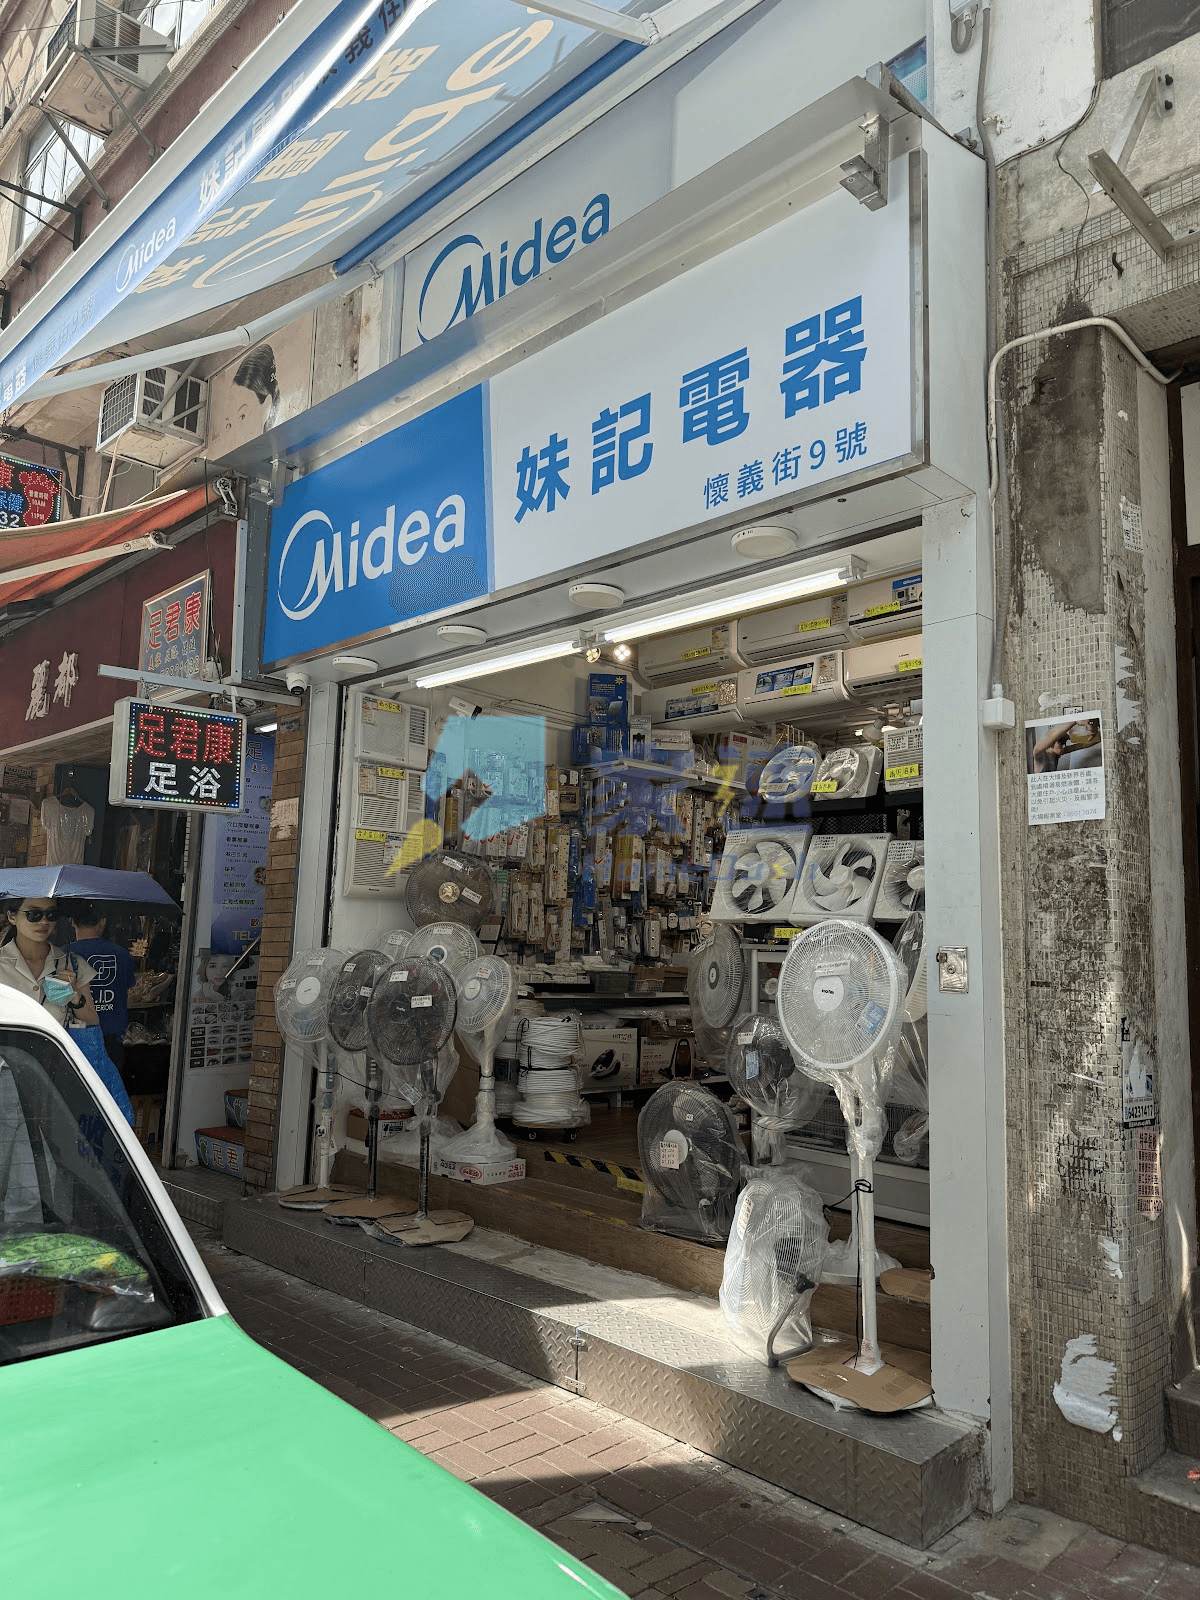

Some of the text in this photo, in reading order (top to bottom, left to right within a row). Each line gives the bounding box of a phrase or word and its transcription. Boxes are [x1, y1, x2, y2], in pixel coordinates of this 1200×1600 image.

[115, 216, 176, 293] Midea
[415, 192, 611, 345] Midea
[514, 294, 868, 524] 妹記電器
[703, 421, 868, 511] 懷義街9號
[277, 493, 467, 622] Midea
[146, 592, 201, 652] 足君康
[134, 712, 235, 766] 足君康
[142, 761, 222, 800] 足浴
